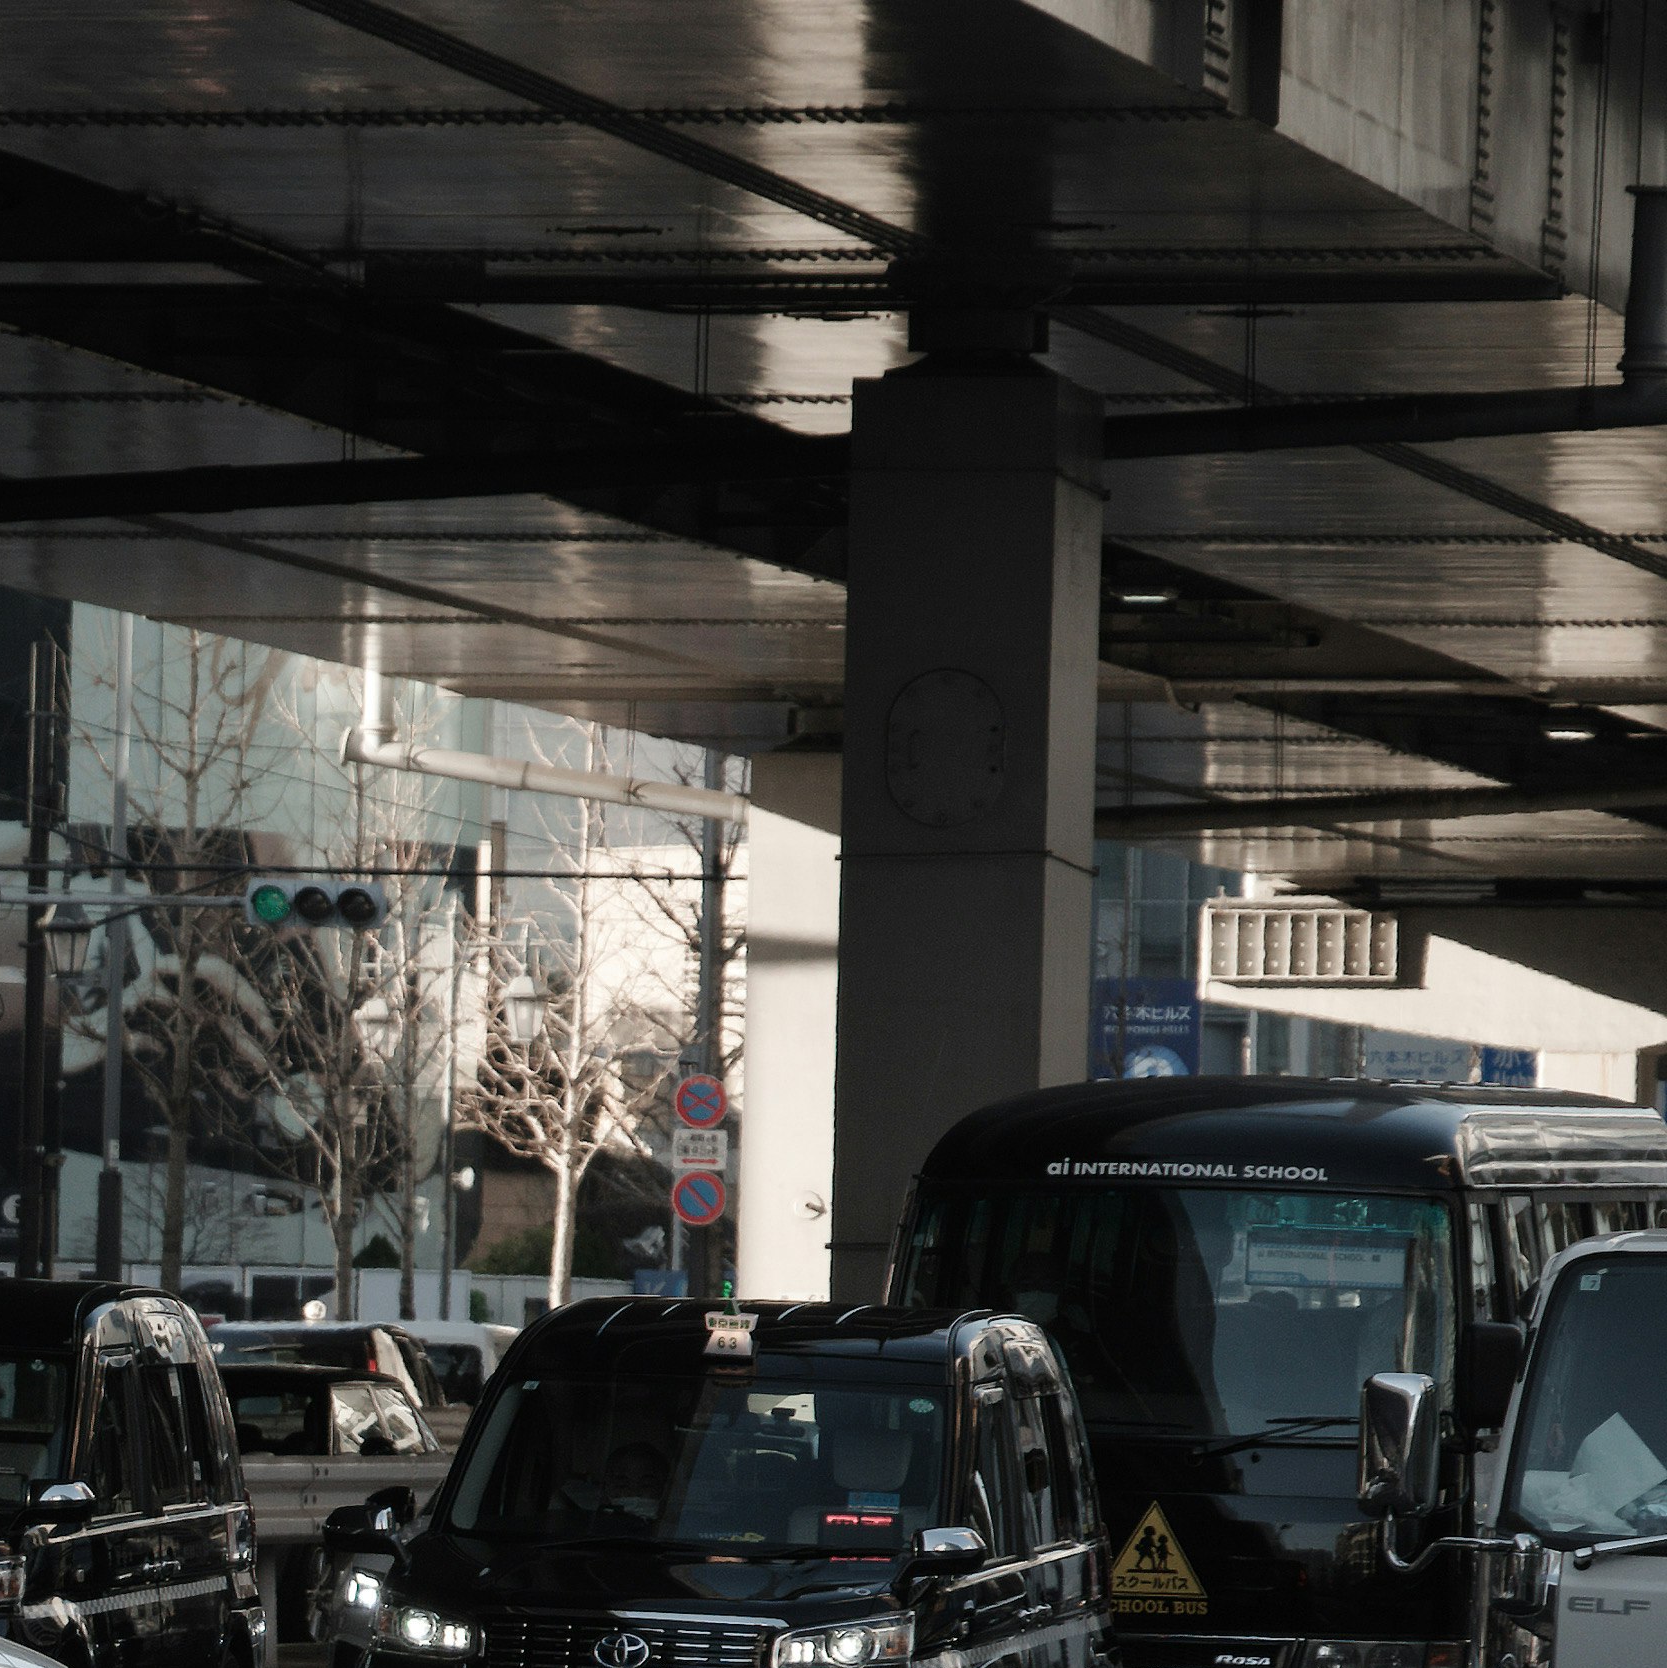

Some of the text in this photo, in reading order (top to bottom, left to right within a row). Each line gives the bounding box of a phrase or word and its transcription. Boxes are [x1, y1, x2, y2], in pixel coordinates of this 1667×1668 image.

[1047, 1157, 1329, 1182] ai INTERNATIONAL SCHOOL
[1115, 1575, 1189, 1590] スクールバス
[1110, 1599, 1209, 1615] CHOOL BUS
[1567, 1596, 1652, 1616] ELF
